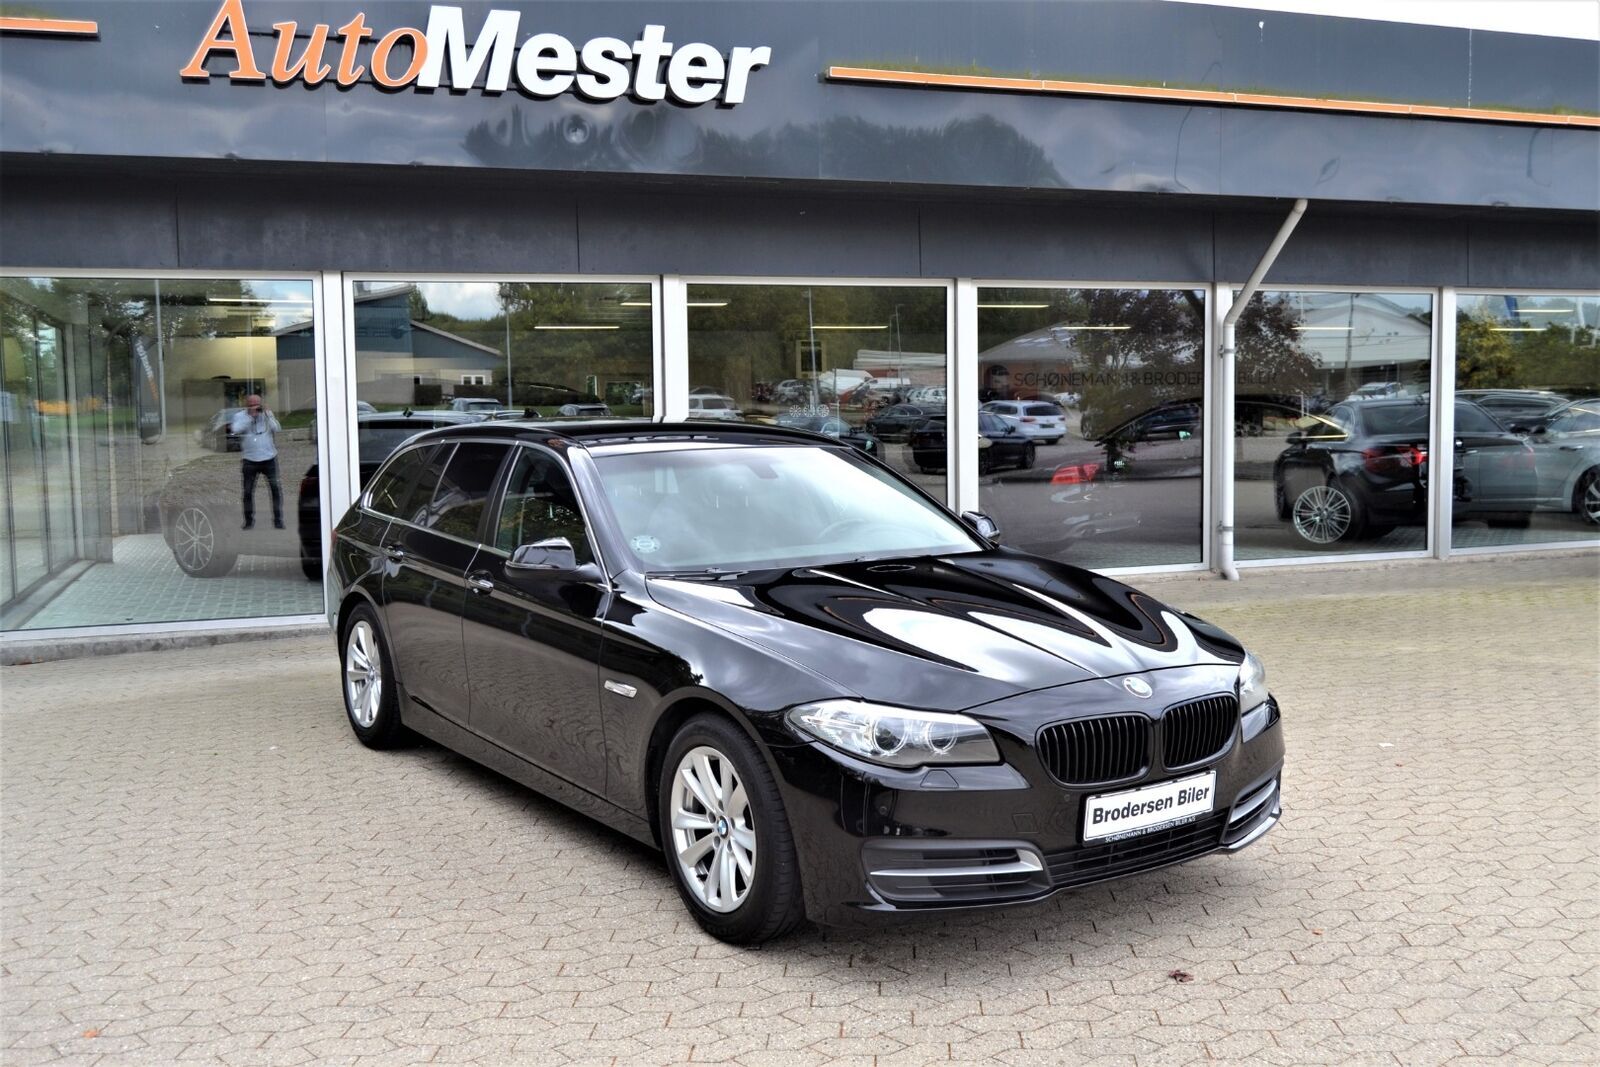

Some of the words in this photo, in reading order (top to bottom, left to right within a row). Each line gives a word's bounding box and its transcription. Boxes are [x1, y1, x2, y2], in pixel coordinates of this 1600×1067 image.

[180, 0, 771, 104] AutoMester
[1144, 371, 1204, 386] BRODER
[1092, 796, 1173, 825] Brodersen
[1177, 787, 1210, 806] Biler
[1147, 822, 1175, 834] BRODERSEN
[1175, 818, 1187, 827] BILER
